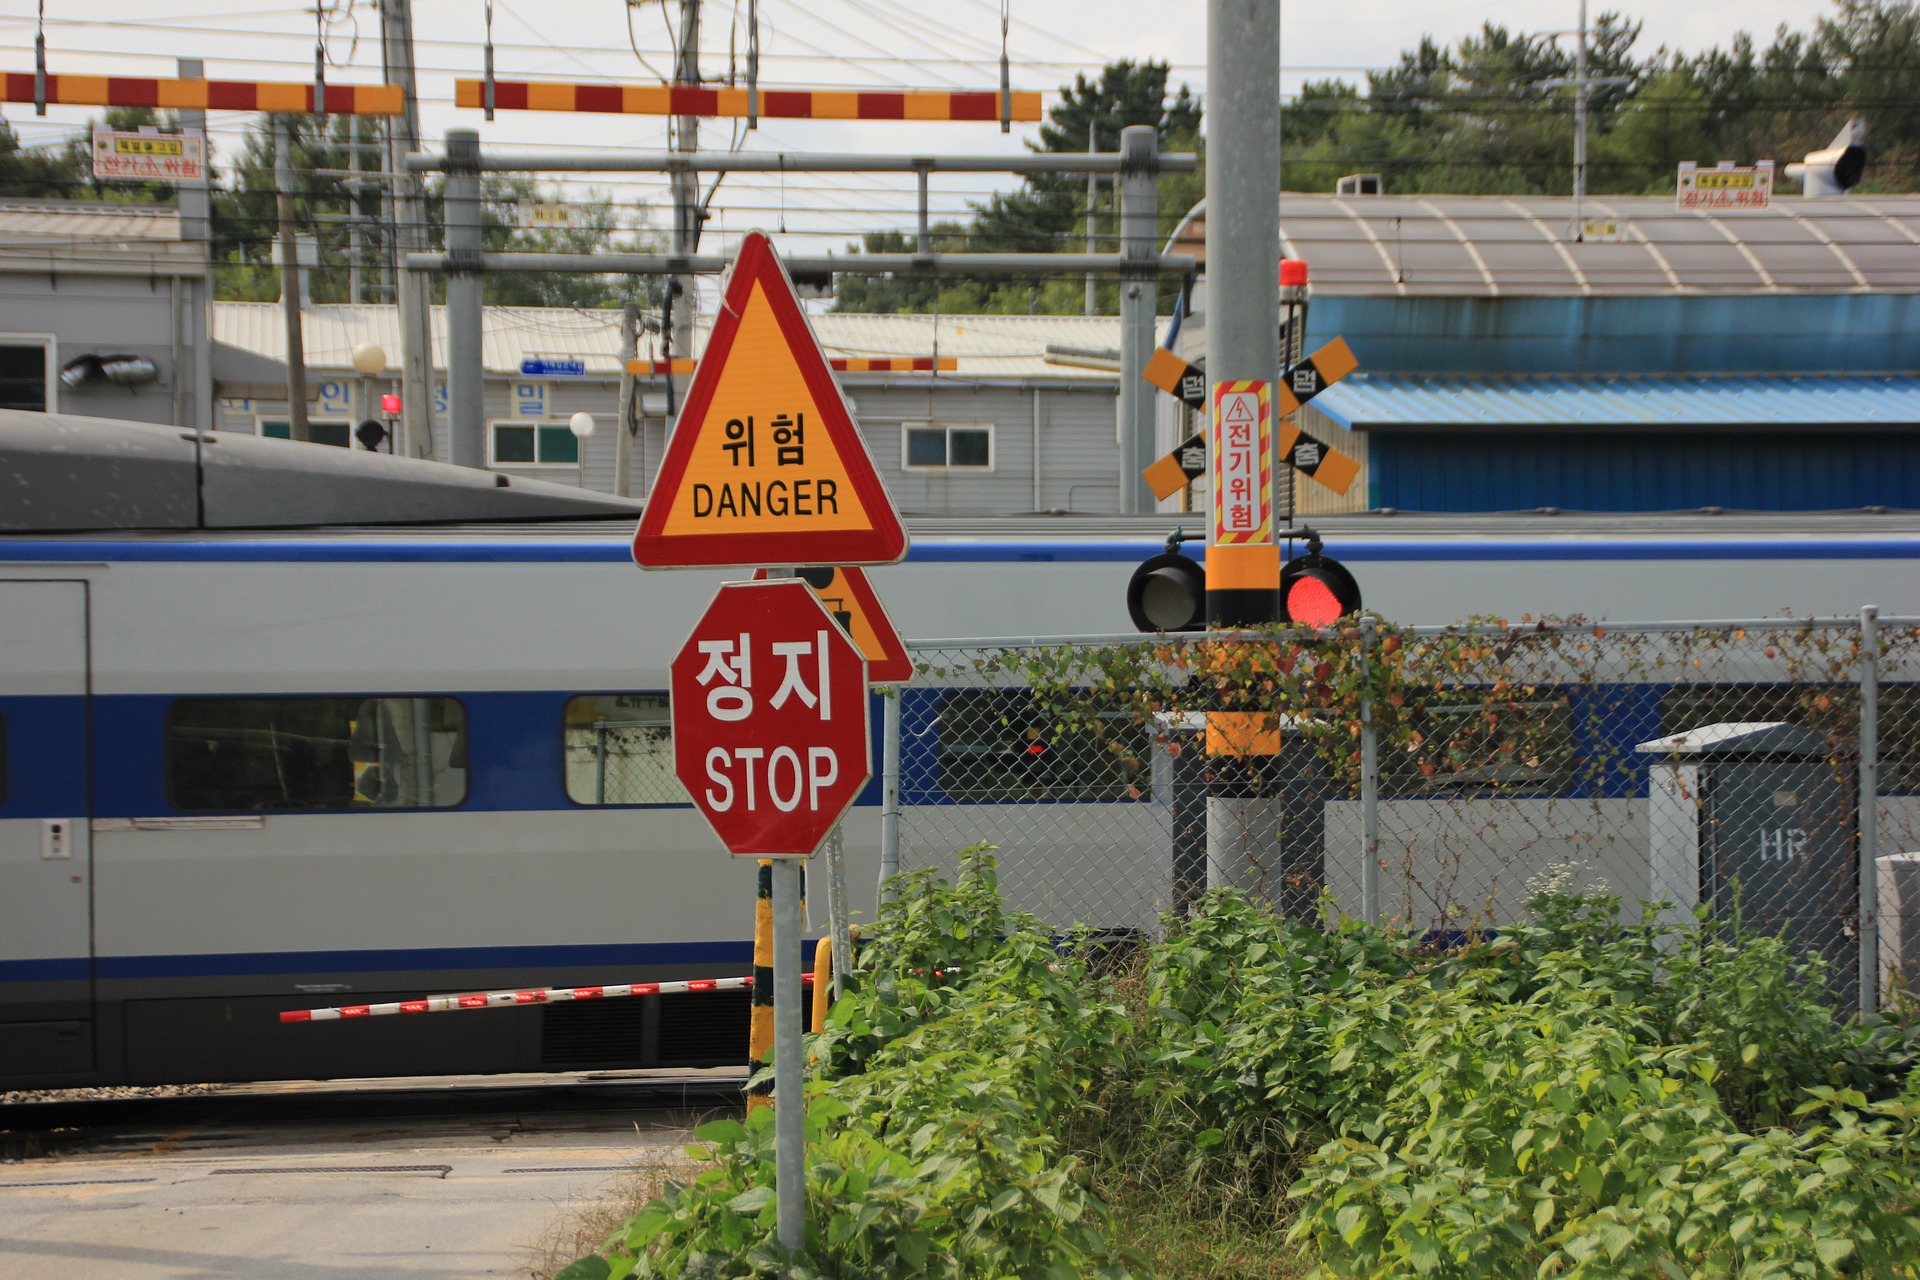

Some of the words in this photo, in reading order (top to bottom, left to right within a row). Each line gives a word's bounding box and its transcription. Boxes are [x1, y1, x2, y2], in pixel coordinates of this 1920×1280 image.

[693, 478, 838, 518] DANGER
[1229, 424, 1252, 529] 전기위험
[695, 629, 831, 721] 정지
[705, 745, 839, 812] STOP
[1760, 828, 1808, 862] HR
